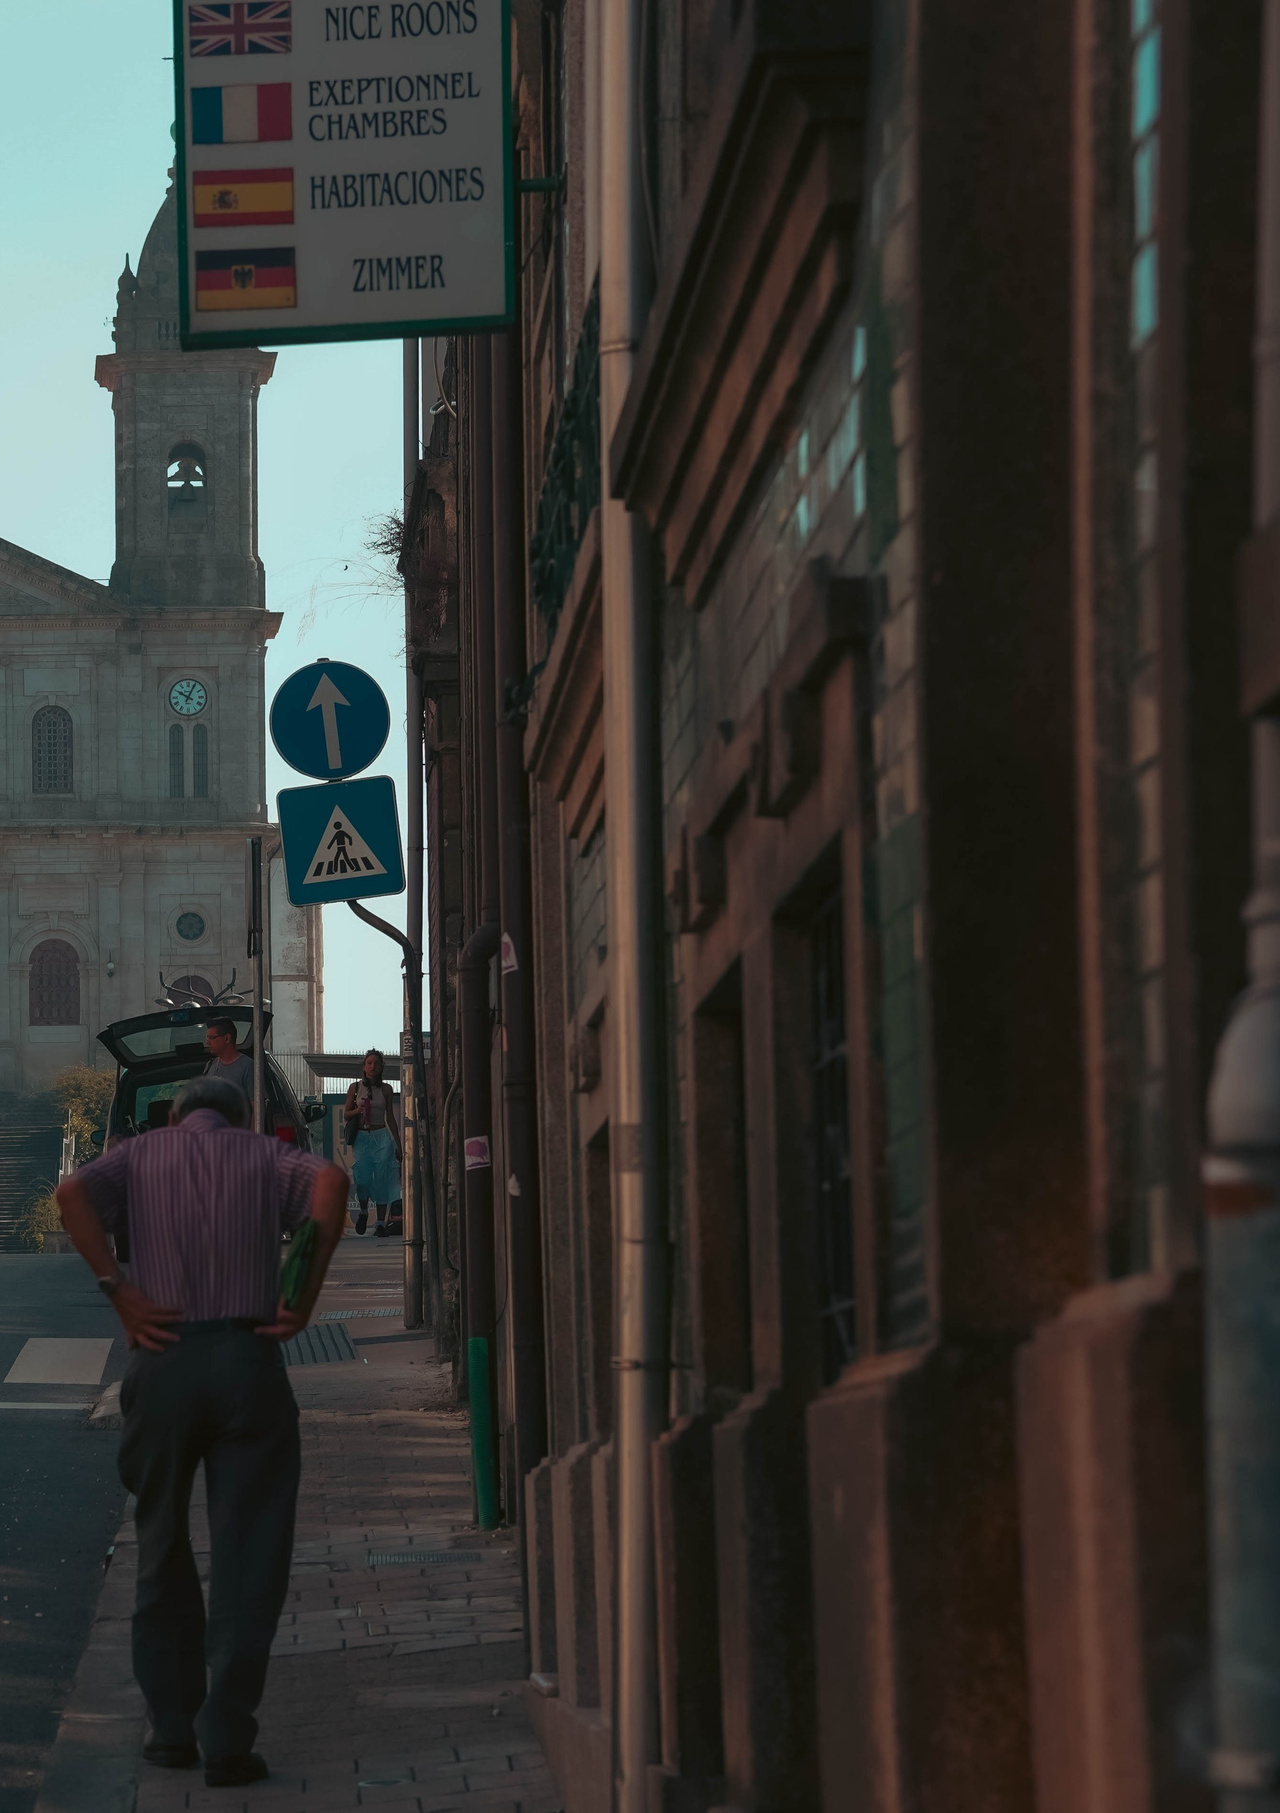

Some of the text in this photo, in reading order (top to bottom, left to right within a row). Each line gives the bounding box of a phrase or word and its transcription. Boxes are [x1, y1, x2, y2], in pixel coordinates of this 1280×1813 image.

[324, 0, 478, 41] NICE ROONS
[308, 72, 481, 108] EXEPTIONNEL
[308, 108, 448, 141] CHAMBRES
[310, 167, 485, 210] HABITACIONES
[353, 255, 446, 293] ZIMMER
